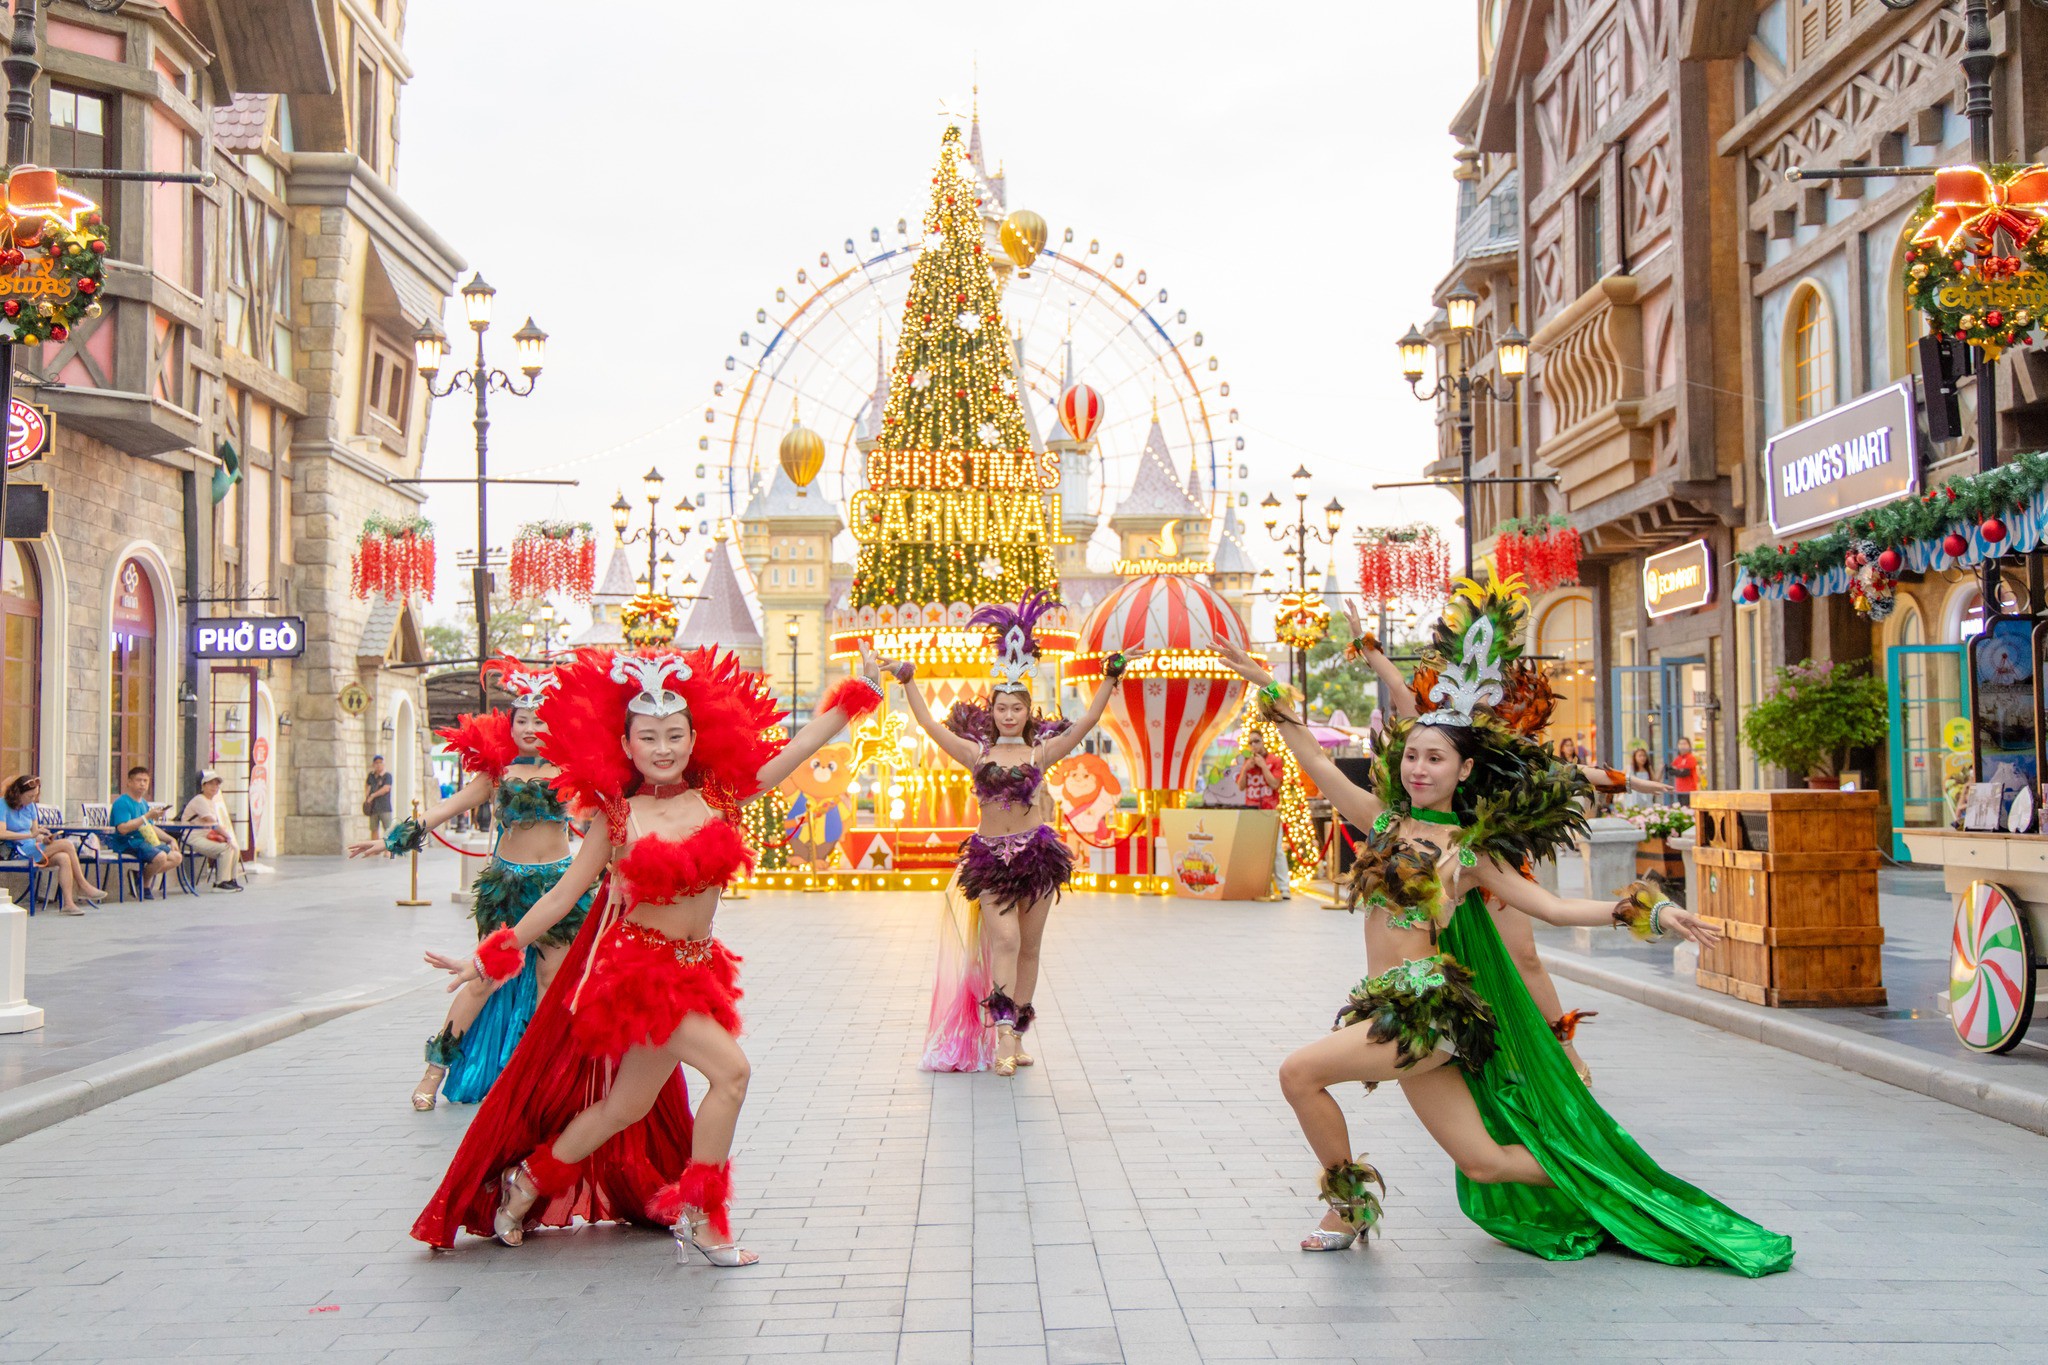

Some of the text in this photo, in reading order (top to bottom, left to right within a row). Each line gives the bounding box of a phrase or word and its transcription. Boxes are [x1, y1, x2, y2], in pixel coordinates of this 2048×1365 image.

[866, 449, 1061, 489] CHRISTMAS
[1782, 426, 1889, 497] HUONG'S MART
[850, 489, 1076, 545] CARNIVAL
[1112, 557, 1216, 576] VinWonders
[198, 621, 298, 652] PHỞ BÒ
[873, 632, 985, 649] HAPPY NEW
